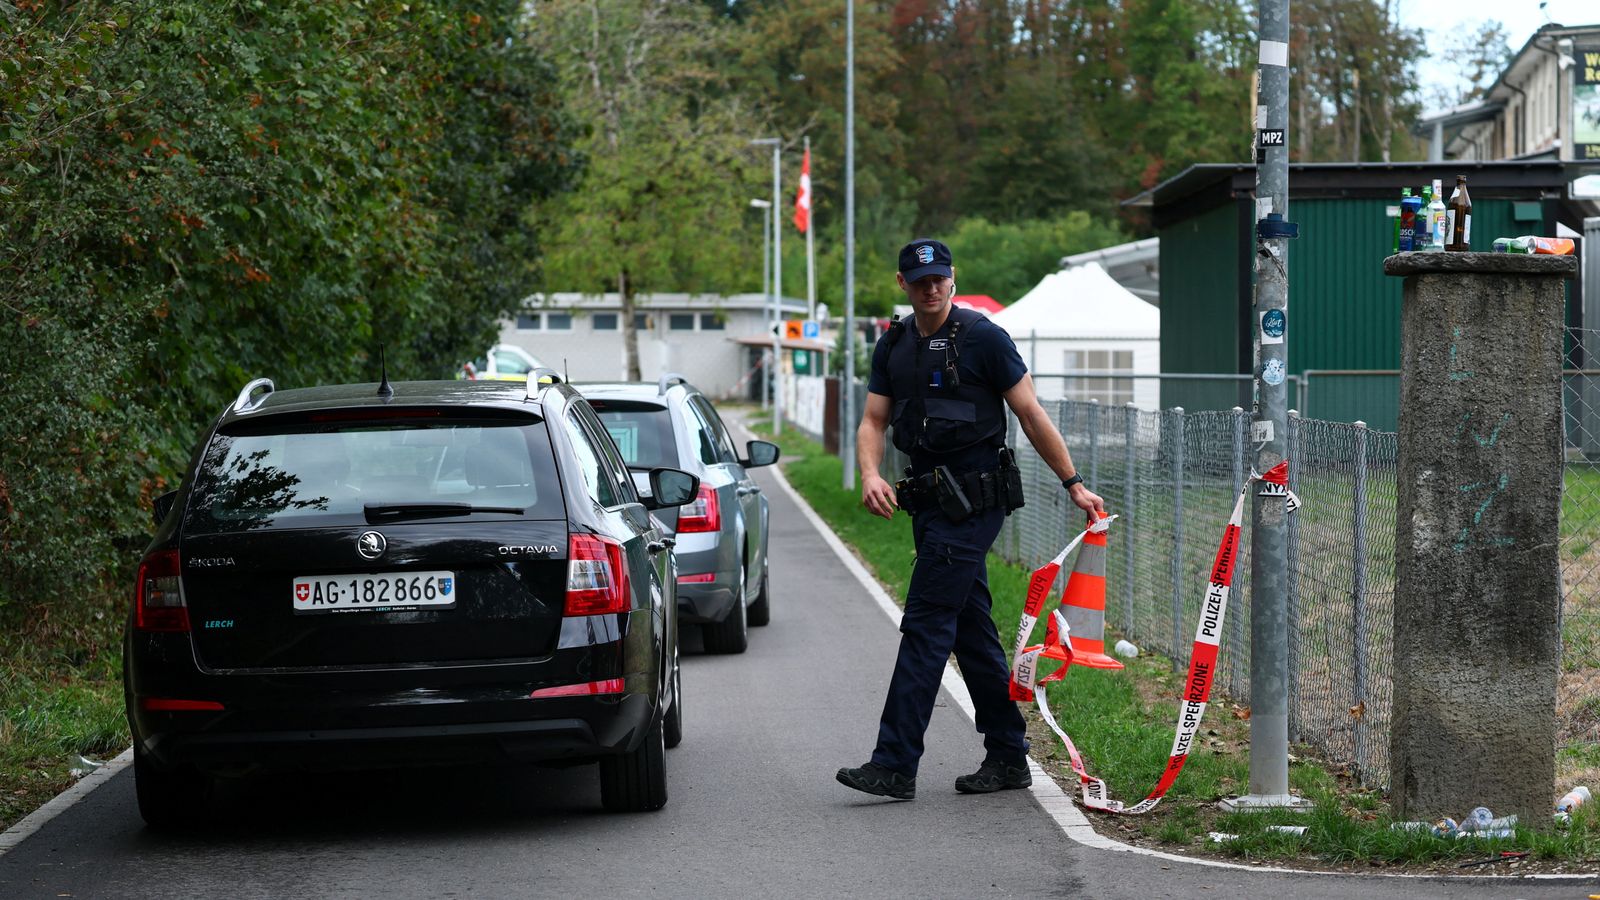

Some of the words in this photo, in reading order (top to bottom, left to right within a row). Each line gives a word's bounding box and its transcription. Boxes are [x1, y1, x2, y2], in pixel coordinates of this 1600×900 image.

[1262, 132, 1282, 144] MPZ
[498, 545, 559, 555] OCTAVIA
[205, 620, 234, 628] LERCH
[1170, 661, 1209, 771] POLIZEI-SPERRZONE
